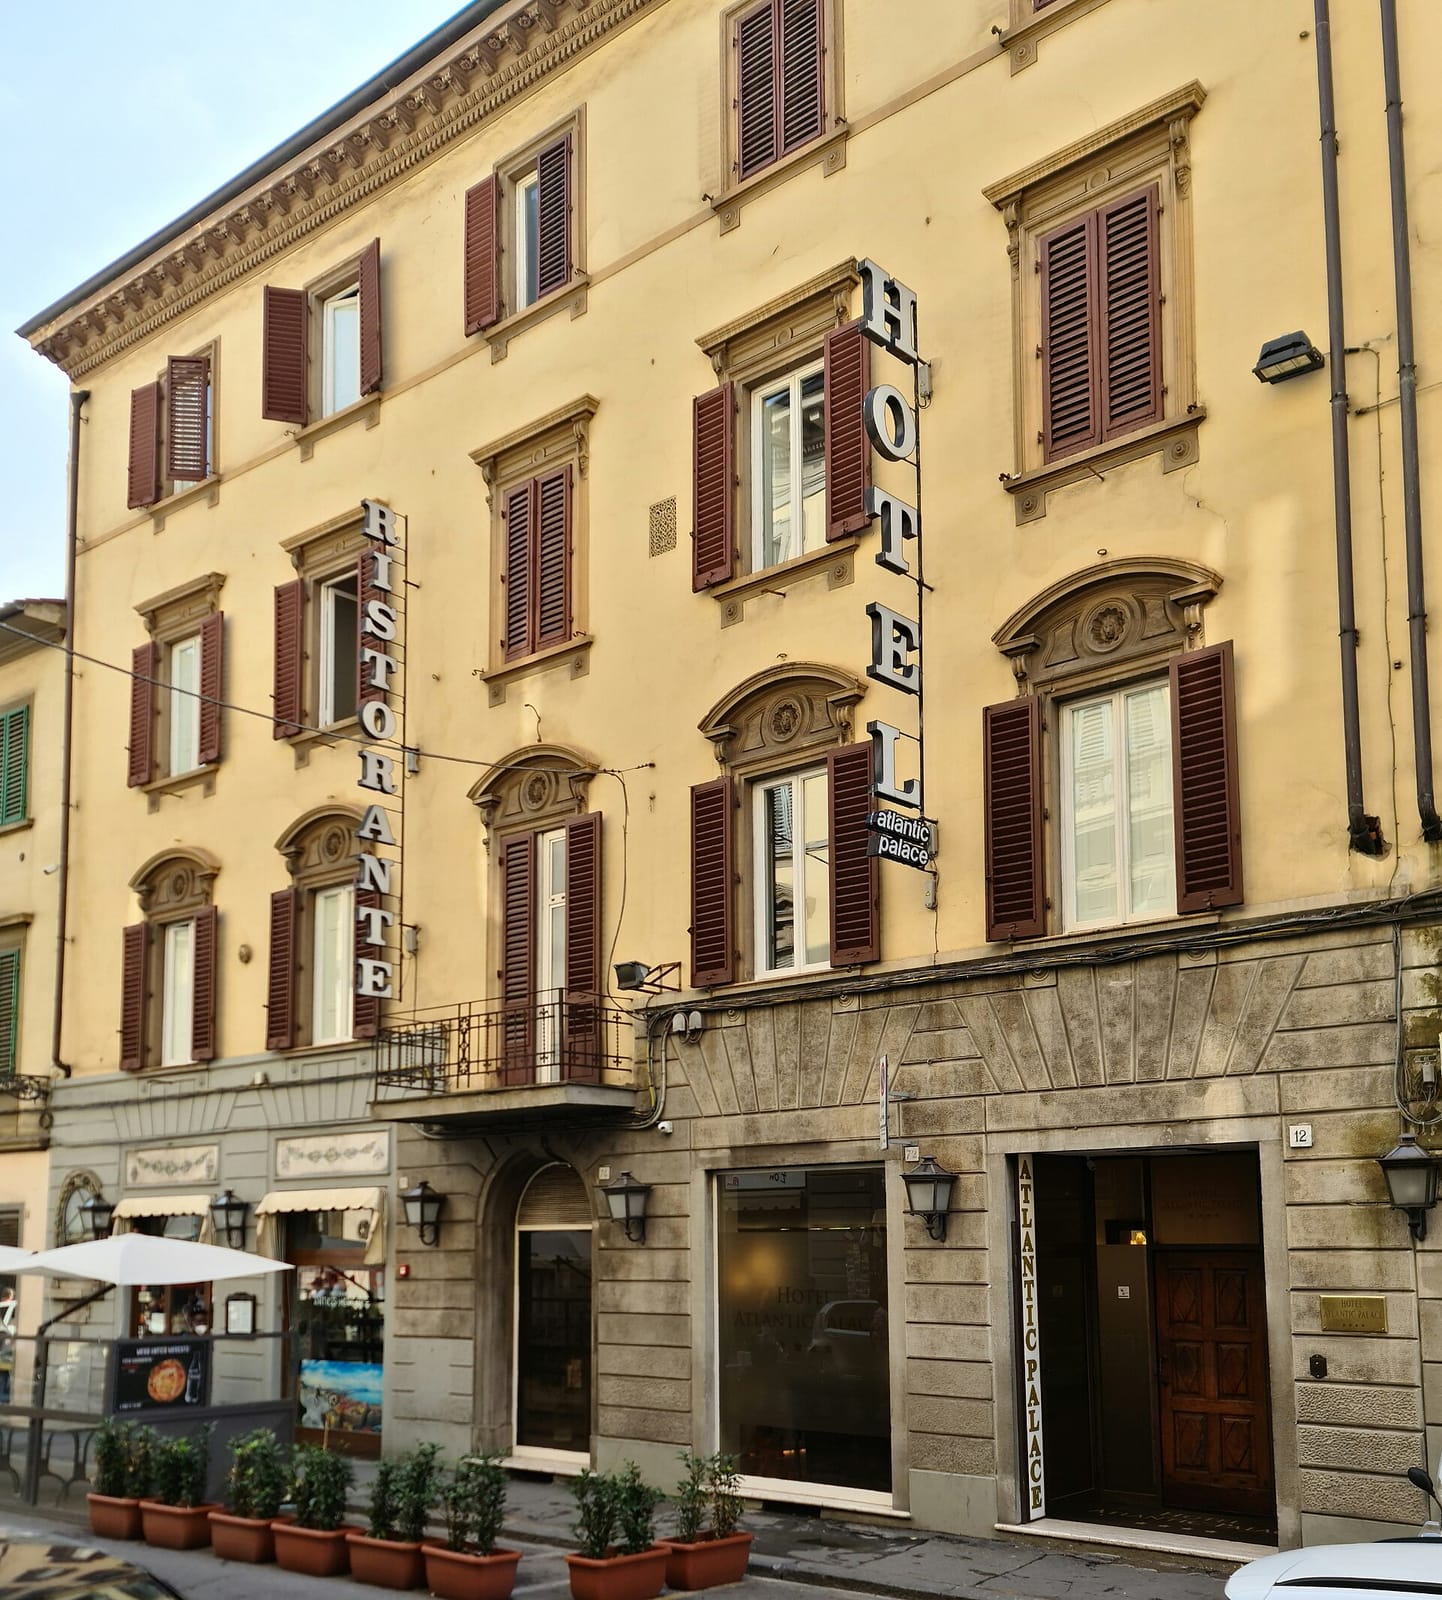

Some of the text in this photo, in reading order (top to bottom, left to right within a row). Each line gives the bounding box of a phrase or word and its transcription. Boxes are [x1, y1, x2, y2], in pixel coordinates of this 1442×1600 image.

[857, 257, 920, 809] HOTEL
[355, 498, 399, 999] RISTORANTE
[877, 811, 929, 842] atlantic
[878, 836, 928, 865] palace
[1295, 1129, 1307, 1142] 12
[1019, 1159, 1037, 1352] ATLANTIC
[1322, 1310, 1384, 1320] ATLANTIC PALACE
[1341, 1299, 1363, 1308] HOTEL
[1026, 1359, 1043, 1510] PALACE
